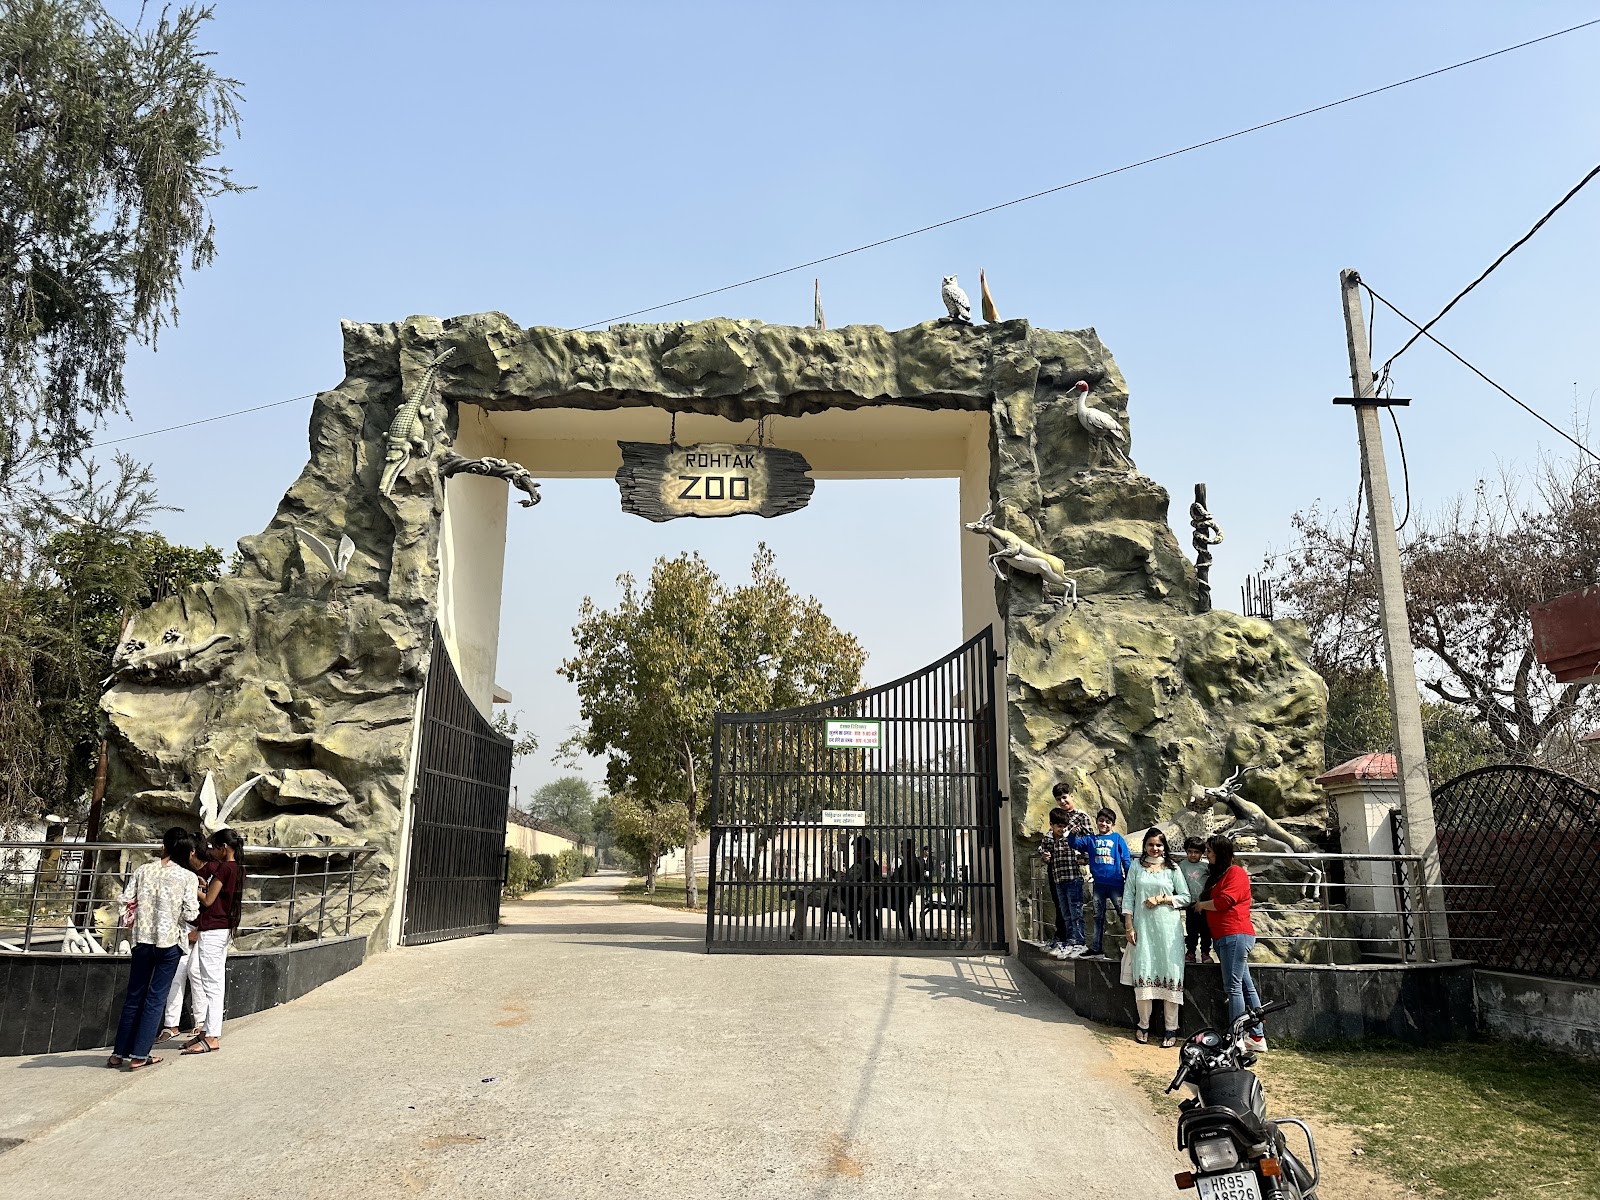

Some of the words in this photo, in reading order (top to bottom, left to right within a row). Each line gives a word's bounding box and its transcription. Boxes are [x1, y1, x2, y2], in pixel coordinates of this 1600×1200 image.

[686, 453, 754, 468] ROHTAK
[678, 475, 749, 500] ZOO
[1096, 847, 1111, 856] THE
[1211, 1175, 1244, 1191] HR95
[1215, 1188, 1255, 1200] A8526
